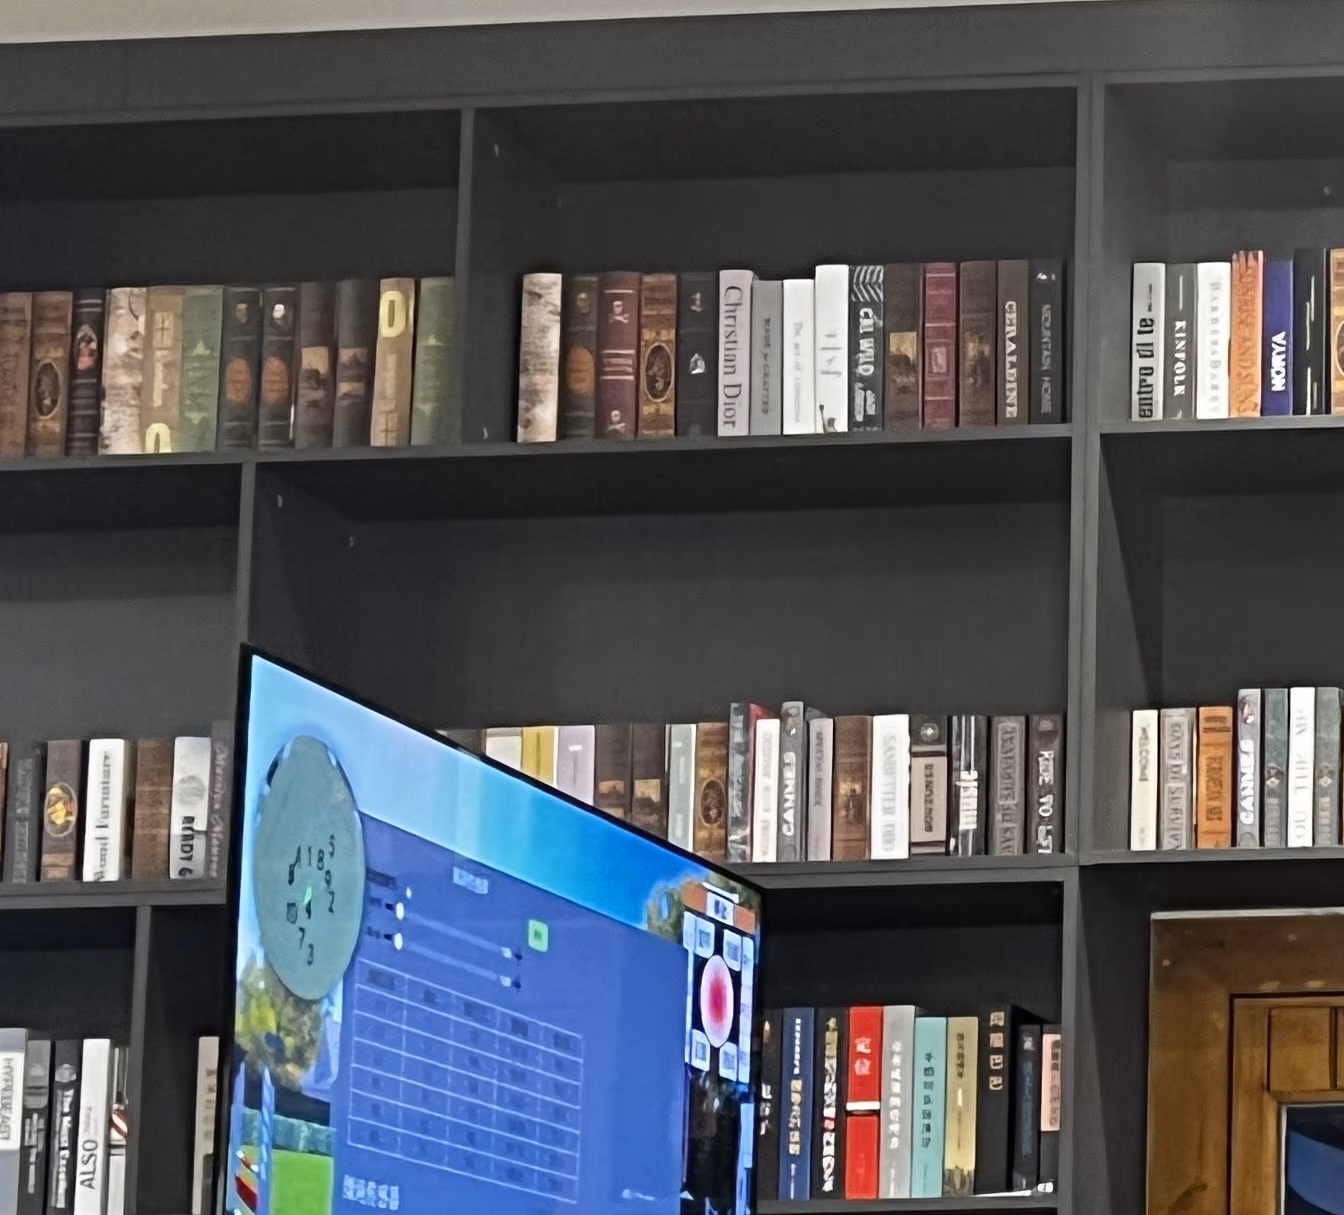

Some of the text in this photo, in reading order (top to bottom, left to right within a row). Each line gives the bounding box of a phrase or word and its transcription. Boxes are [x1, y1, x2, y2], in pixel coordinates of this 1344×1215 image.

[721, 285, 745, 429] Christian Dior
[79, 1139, 99, 1190] ALSO
